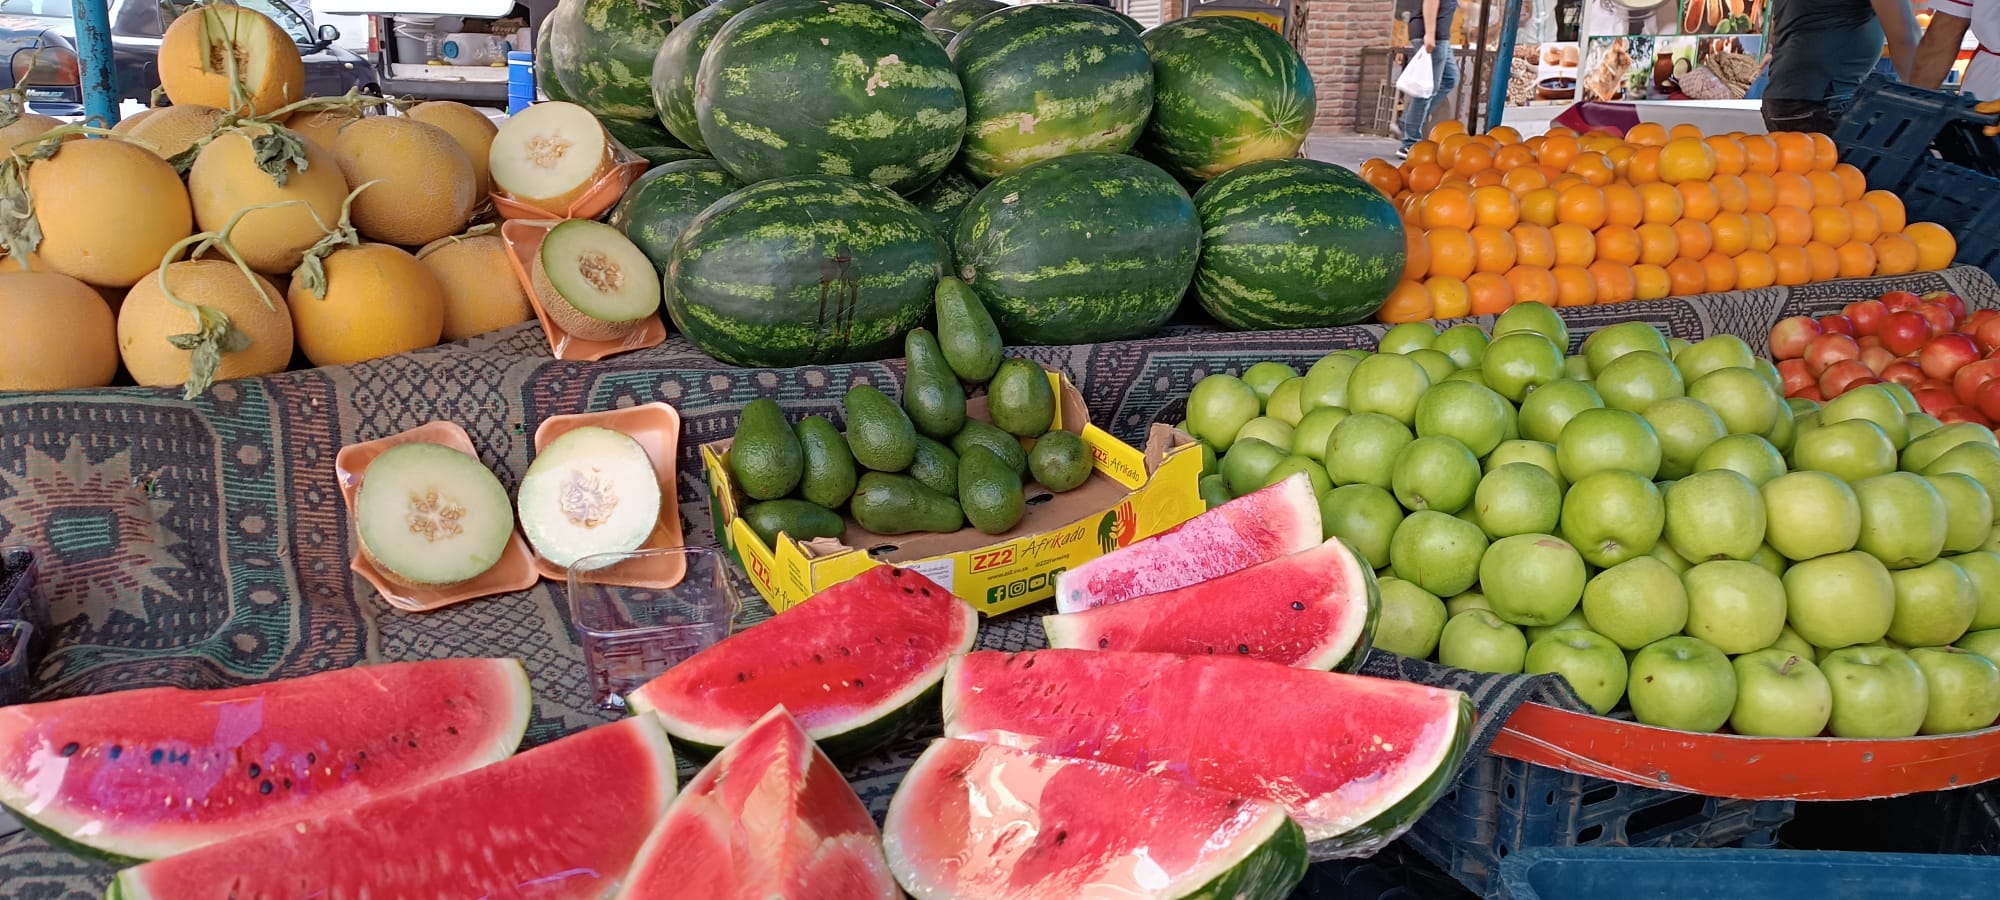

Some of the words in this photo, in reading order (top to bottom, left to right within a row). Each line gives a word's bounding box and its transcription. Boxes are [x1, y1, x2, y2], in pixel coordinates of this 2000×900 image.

[1092, 445, 1108, 465] ZZ2
[1110, 457, 1140, 482] Afrikado
[973, 549, 1013, 571] ZZ2
[1021, 526, 1086, 559] Afrikado
[750, 551, 772, 593] ZZ2
